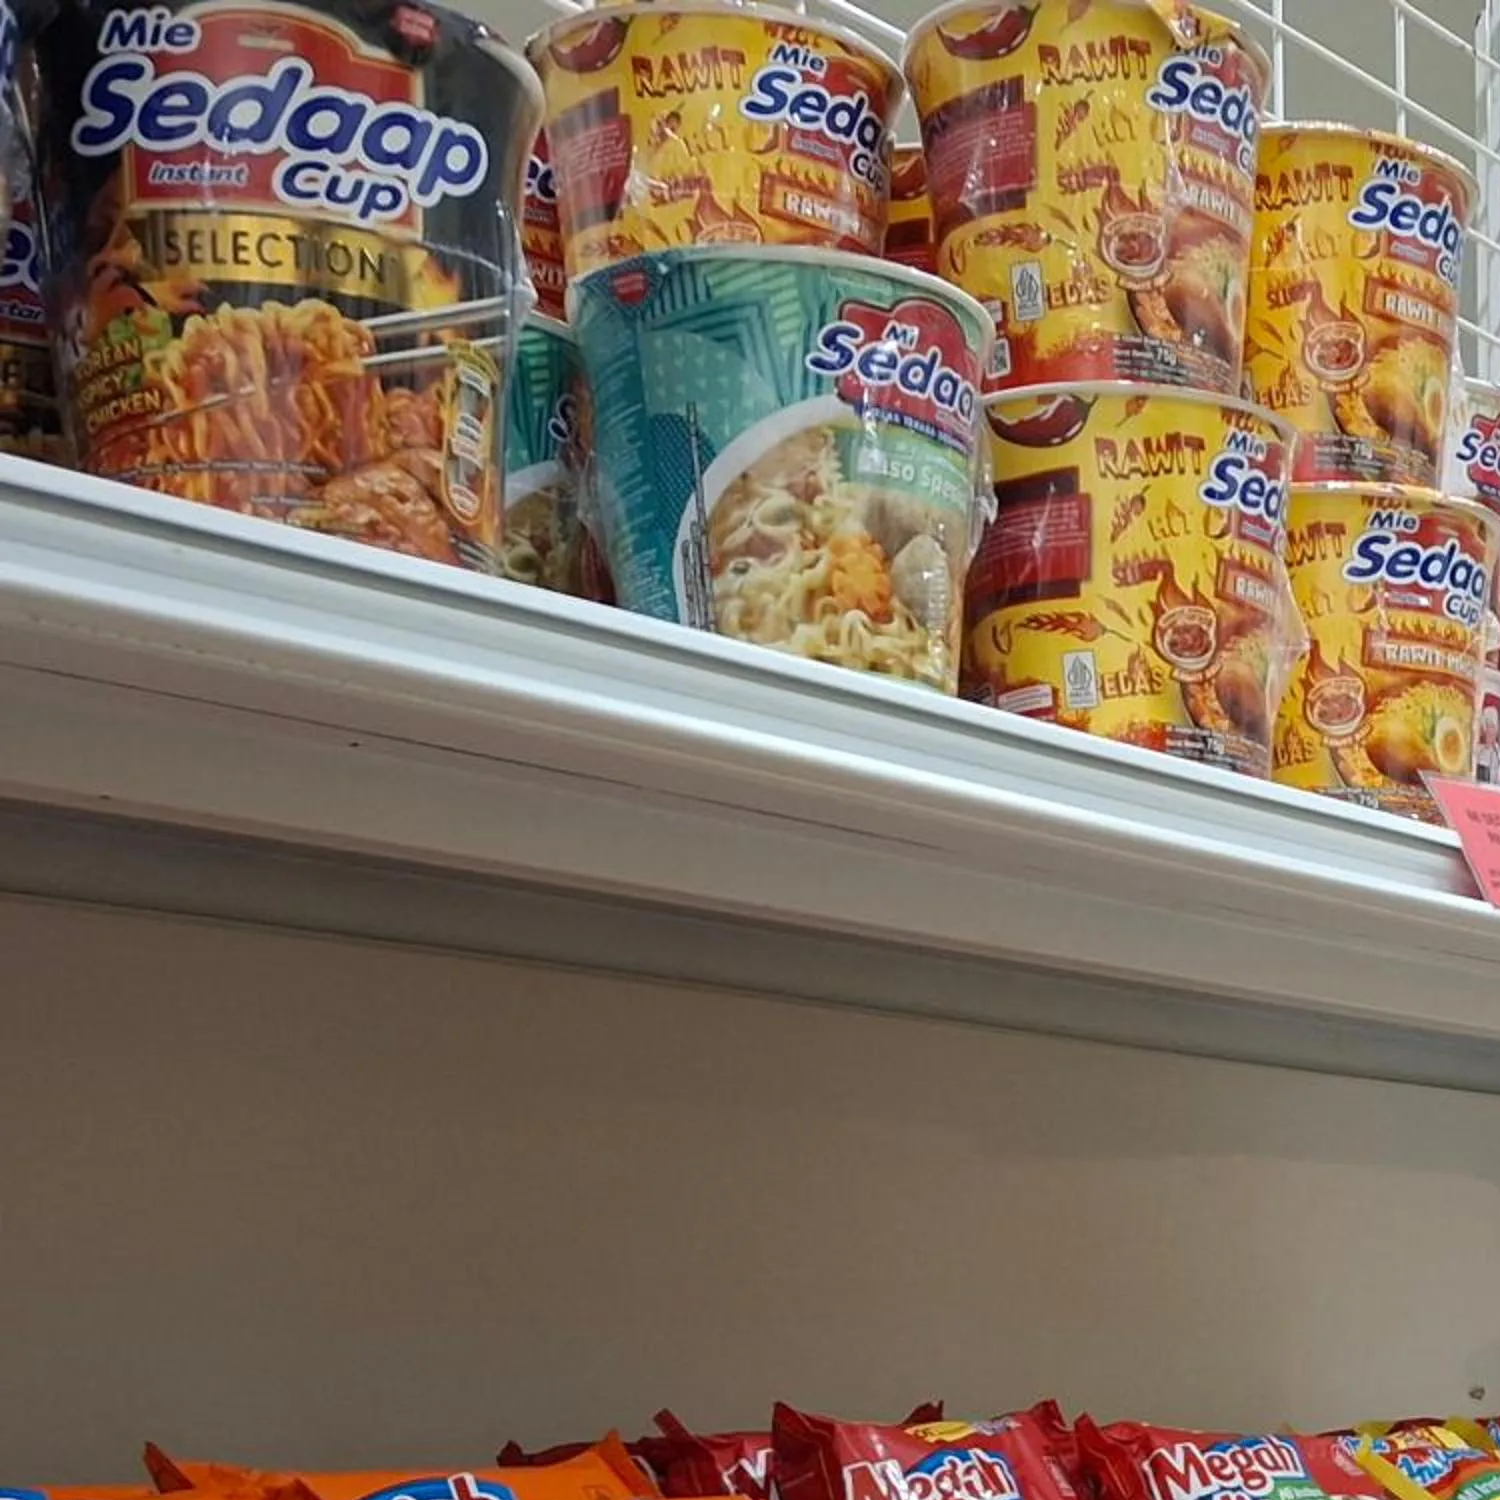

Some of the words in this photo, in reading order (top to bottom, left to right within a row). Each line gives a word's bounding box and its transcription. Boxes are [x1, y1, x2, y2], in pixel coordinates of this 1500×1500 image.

[103, 12, 196, 49] Mie
[632, 45, 746, 98] RAWIT
[772, 43, 827, 73] Mie
[1037, 35, 1152, 87] RAWIT
[78, 63, 486, 196] Sedaap
[280, 160, 404, 219] Cup
[1254, 161, 1355, 213] RAWIT
[1375, 157, 1422, 185] Mie
[165, 229, 386, 285] SELECTION
[1047, 276, 1113, 310] EDAS
[883, 320, 920, 350] Mi
[1094, 431, 1207, 480] RAWIT
[1369, 508, 1420, 533] Mie
[1443, 592, 1481, 627] Cup
[1100, 666, 1165, 700] EDAS
